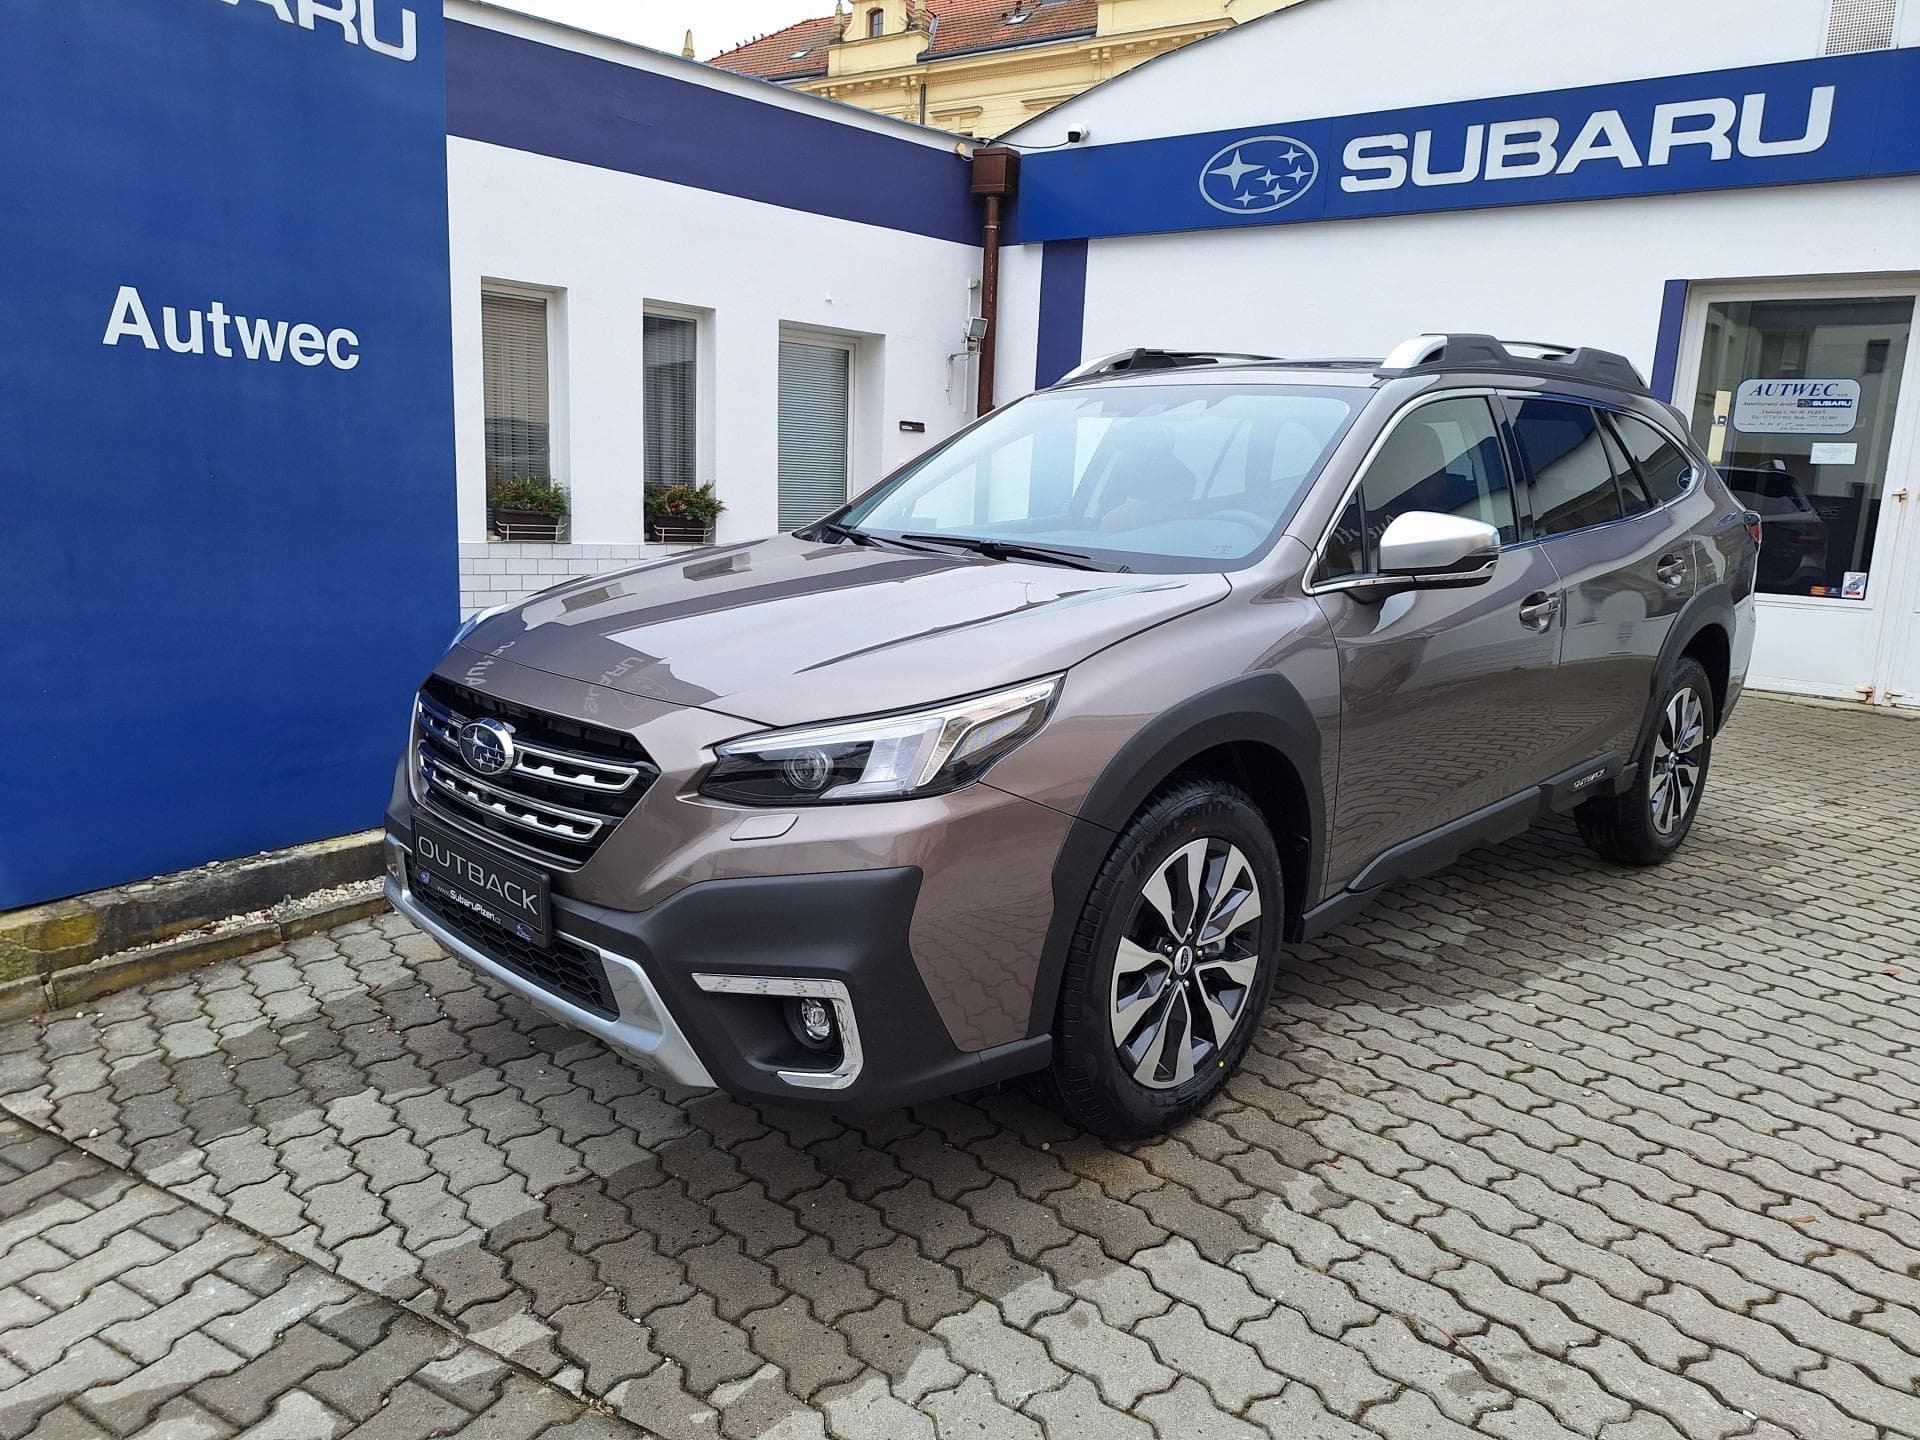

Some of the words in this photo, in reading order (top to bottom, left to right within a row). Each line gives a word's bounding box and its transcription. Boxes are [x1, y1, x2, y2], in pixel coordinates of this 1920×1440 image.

[1340, 85, 1835, 193] SUBARU
[102, 284, 360, 370] Autwec
[1749, 383, 1839, 397] AUTWEC
[1573, 768, 1606, 789] OUTBACK
[417, 835, 538, 916] OUTBACK
